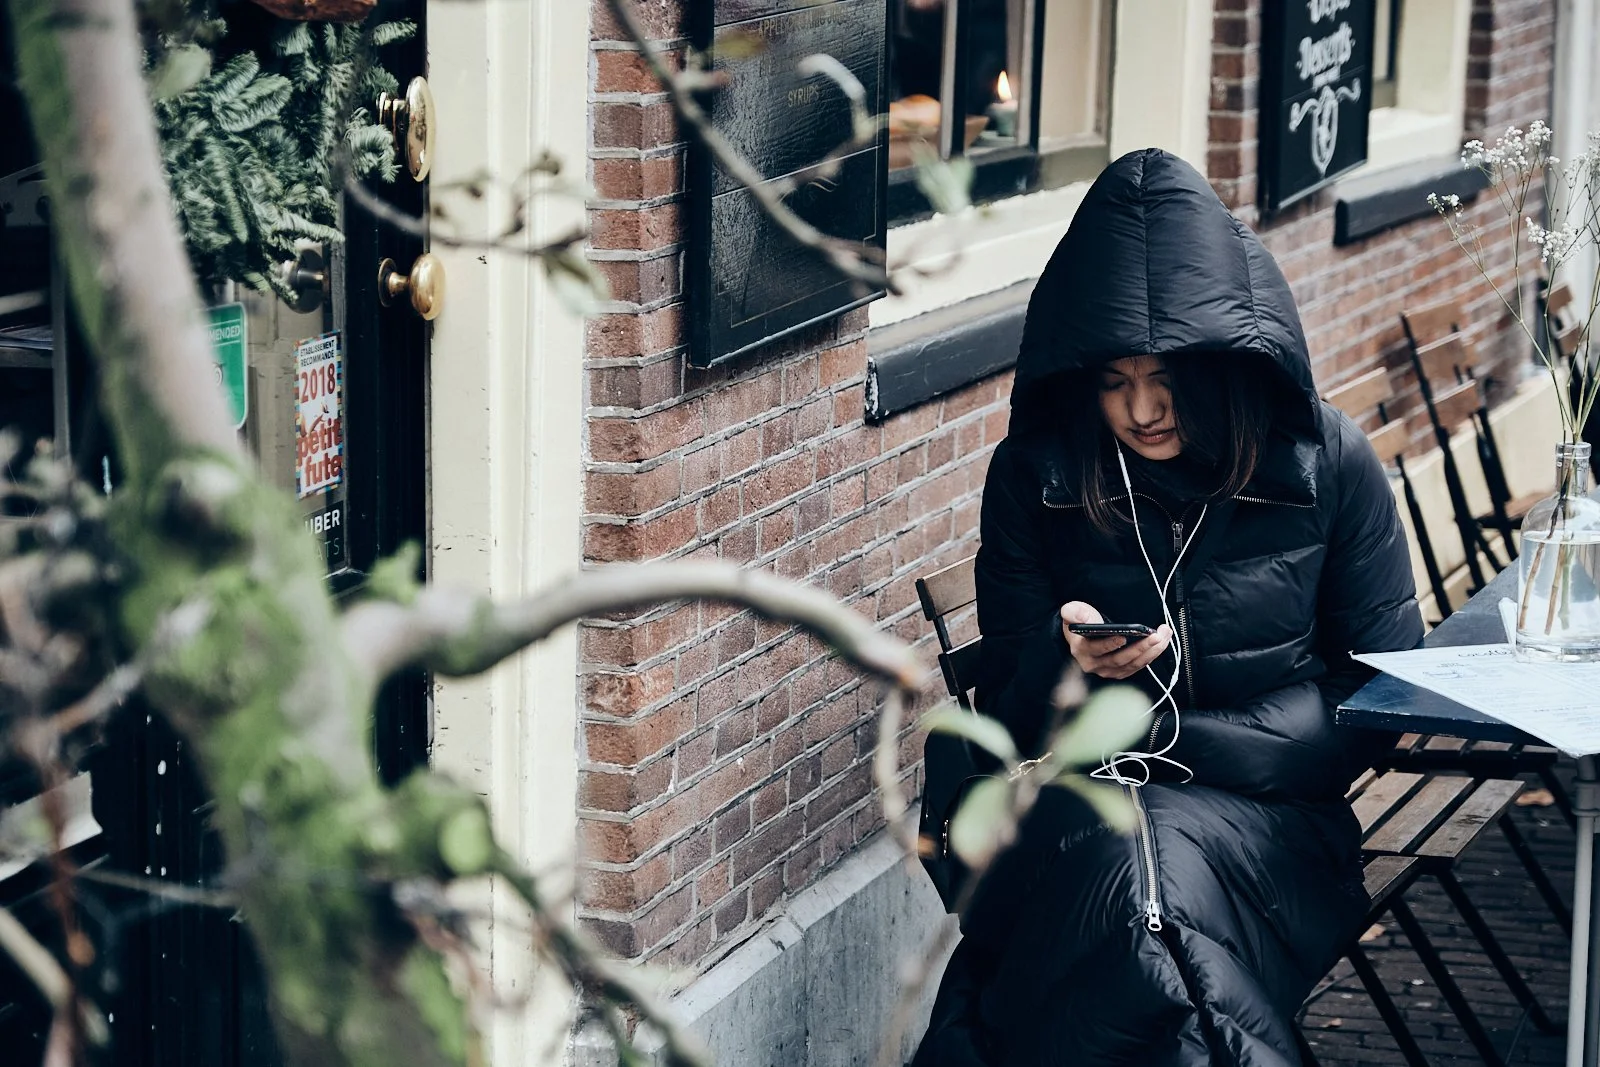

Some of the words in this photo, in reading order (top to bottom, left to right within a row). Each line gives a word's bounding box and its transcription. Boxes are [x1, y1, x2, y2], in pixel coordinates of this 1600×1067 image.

[788, 85, 819, 107] SYRUPS
[207, 325, 241, 342] MENDED
[301, 362, 336, 404] 2018
[297, 418, 342, 466] petit
[305, 509, 340, 536] UBER
[317, 537, 340, 560] ATS
